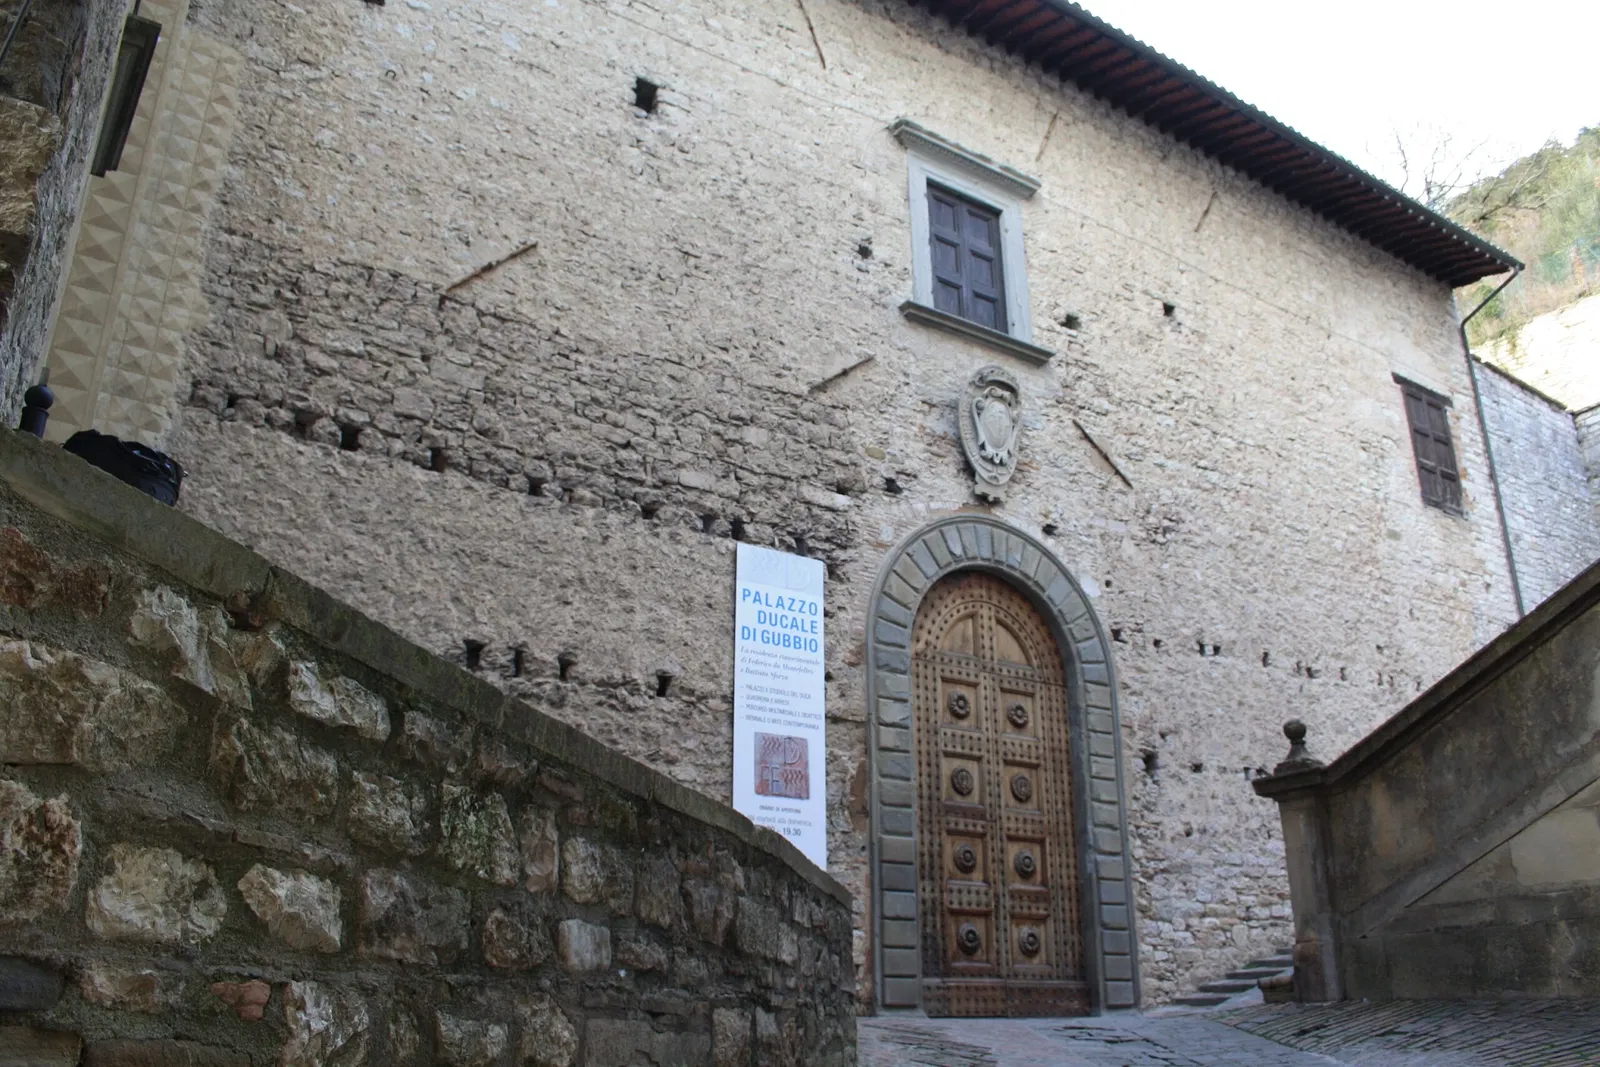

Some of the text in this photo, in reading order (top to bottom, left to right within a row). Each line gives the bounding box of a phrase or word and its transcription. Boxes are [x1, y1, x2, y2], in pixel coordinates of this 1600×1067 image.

[742, 588, 818, 616] PALAZZO
[757, 610, 818, 634] DUCALE
[741, 626, 818, 653] DI GUBBIO
